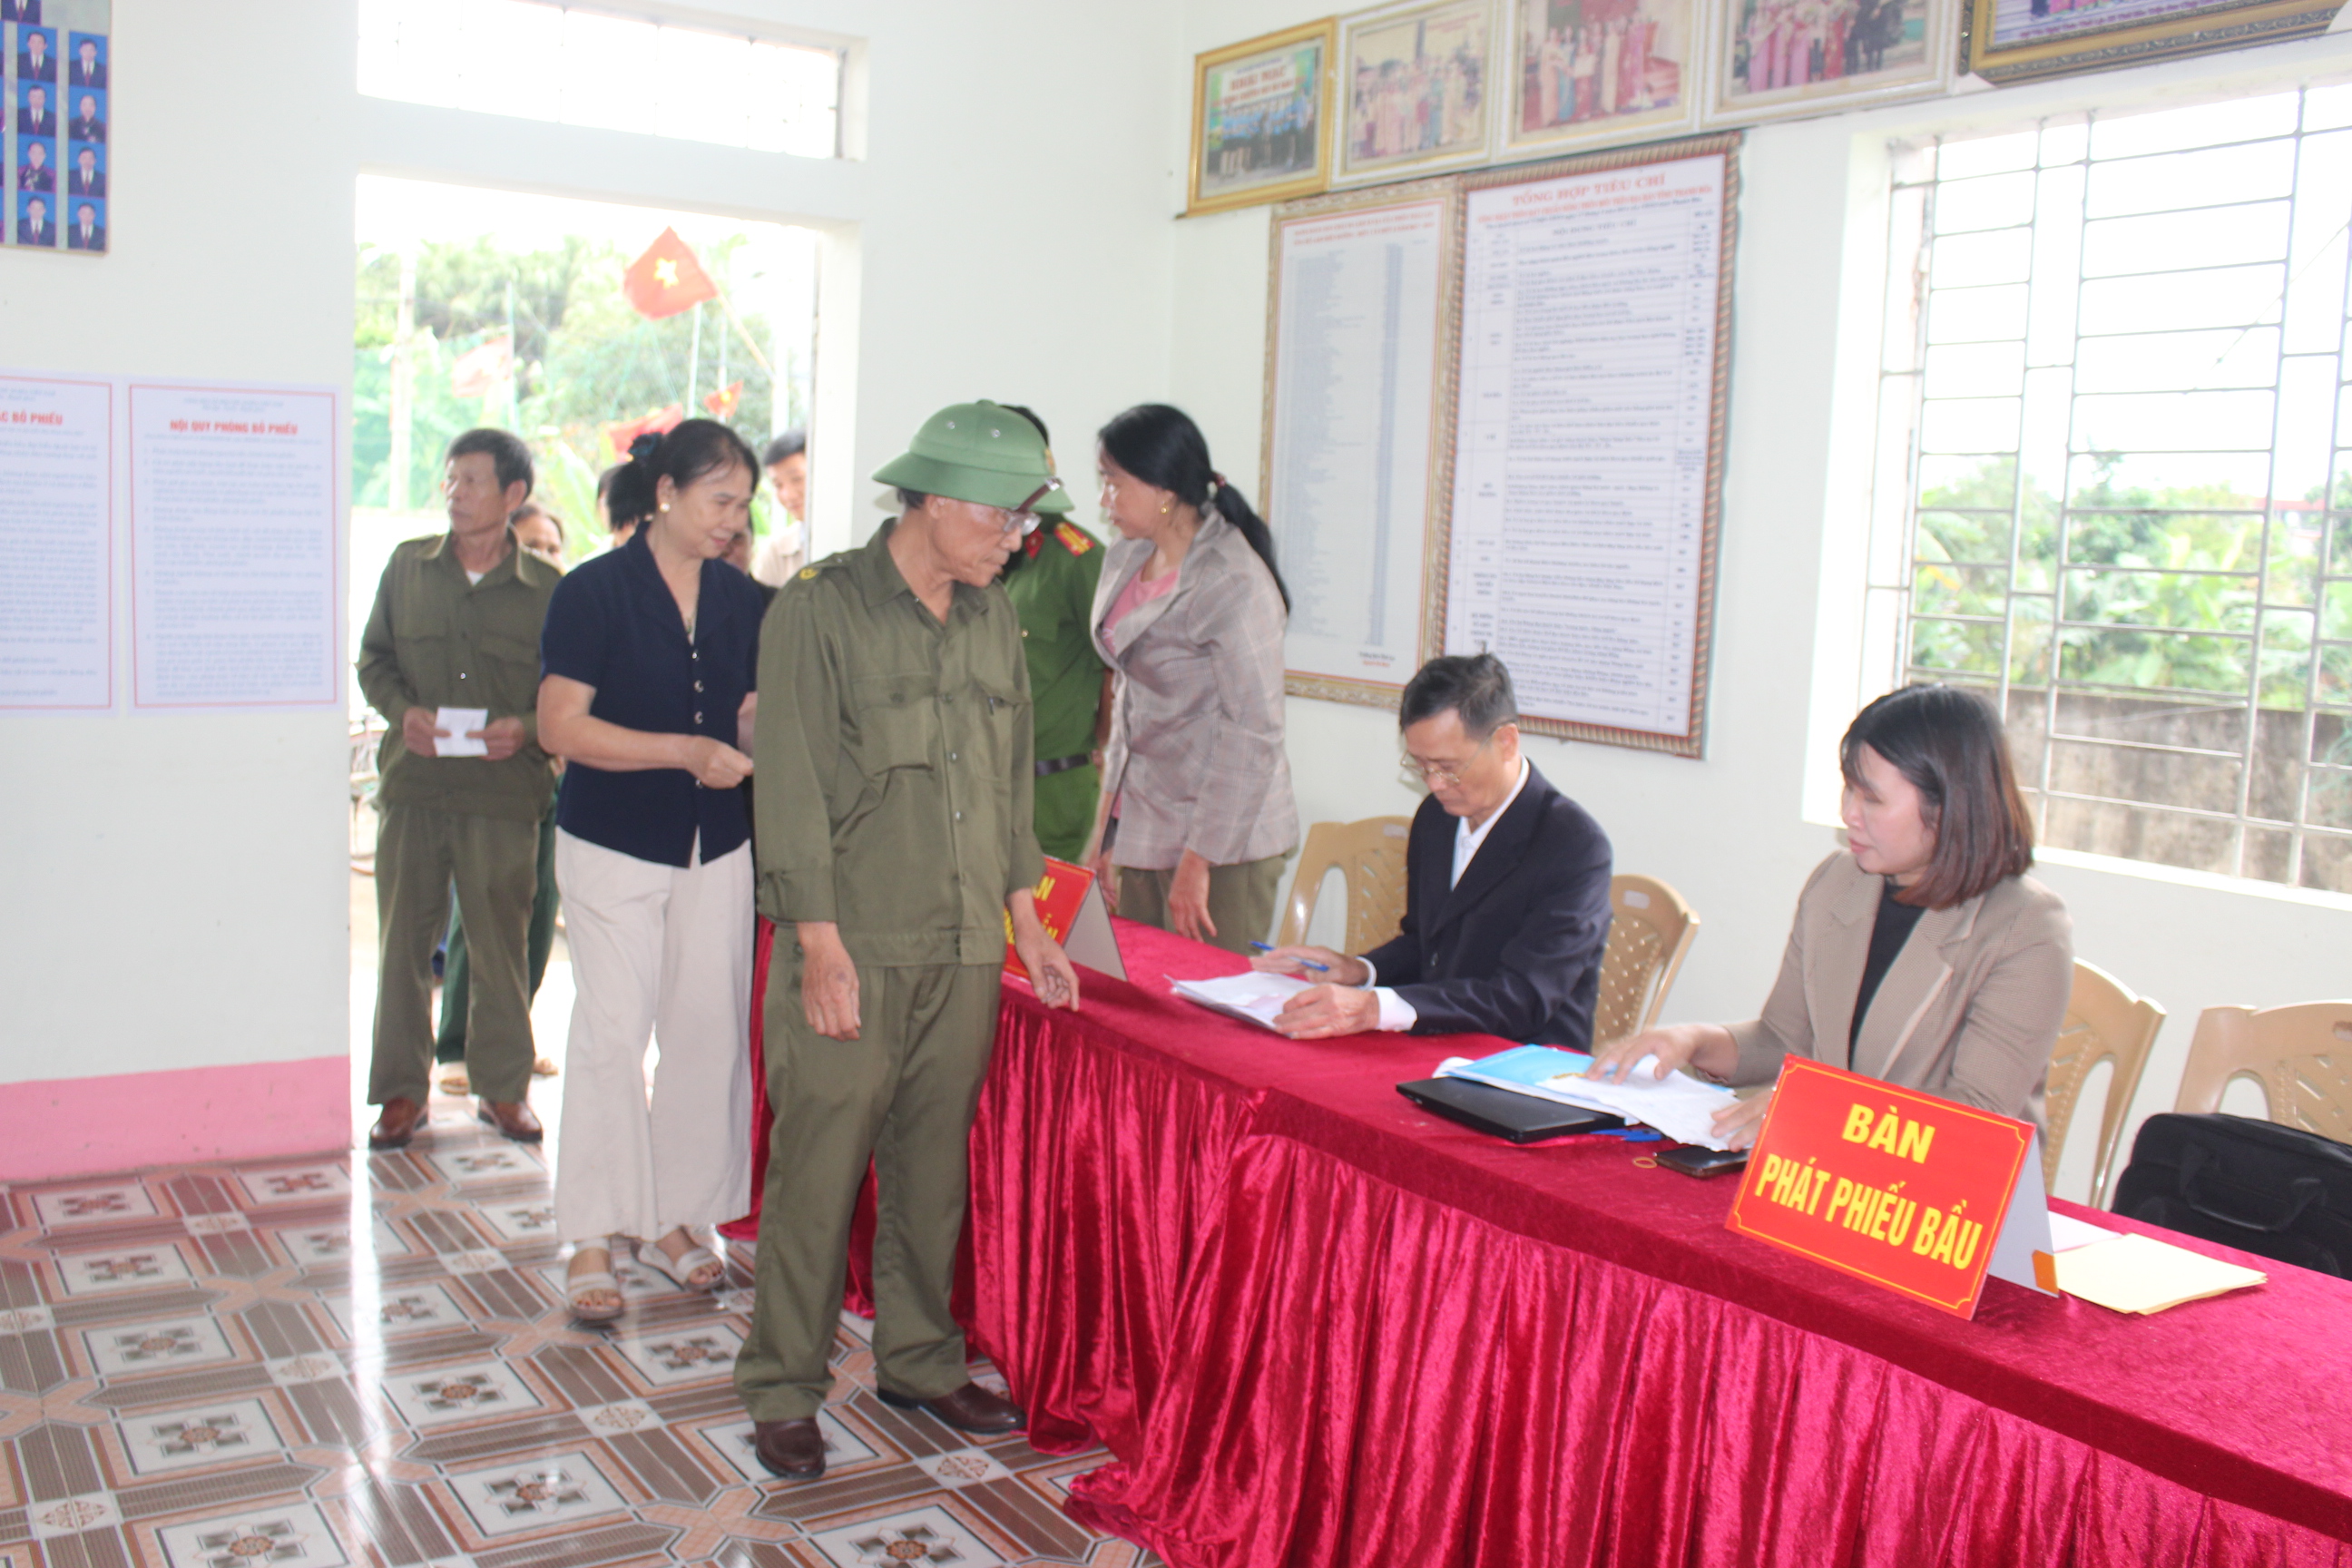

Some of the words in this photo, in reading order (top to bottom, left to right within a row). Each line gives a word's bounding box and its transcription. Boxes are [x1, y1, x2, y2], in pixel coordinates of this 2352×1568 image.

[1513, 188, 1553, 206] TỔNG
[1556, 185, 1590, 201] HỢP
[1635, 172, 1666, 189] CHÍ
[30, 410, 64, 426] PHIẾU
[170, 418, 188, 432] NỘI
[1841, 1102, 1936, 1164] BÀN
[1754, 1152, 1831, 1216] PHÁT
[1825, 1177, 1917, 1247] PHIẾU
[1912, 1199, 1984, 1270] BẦU
